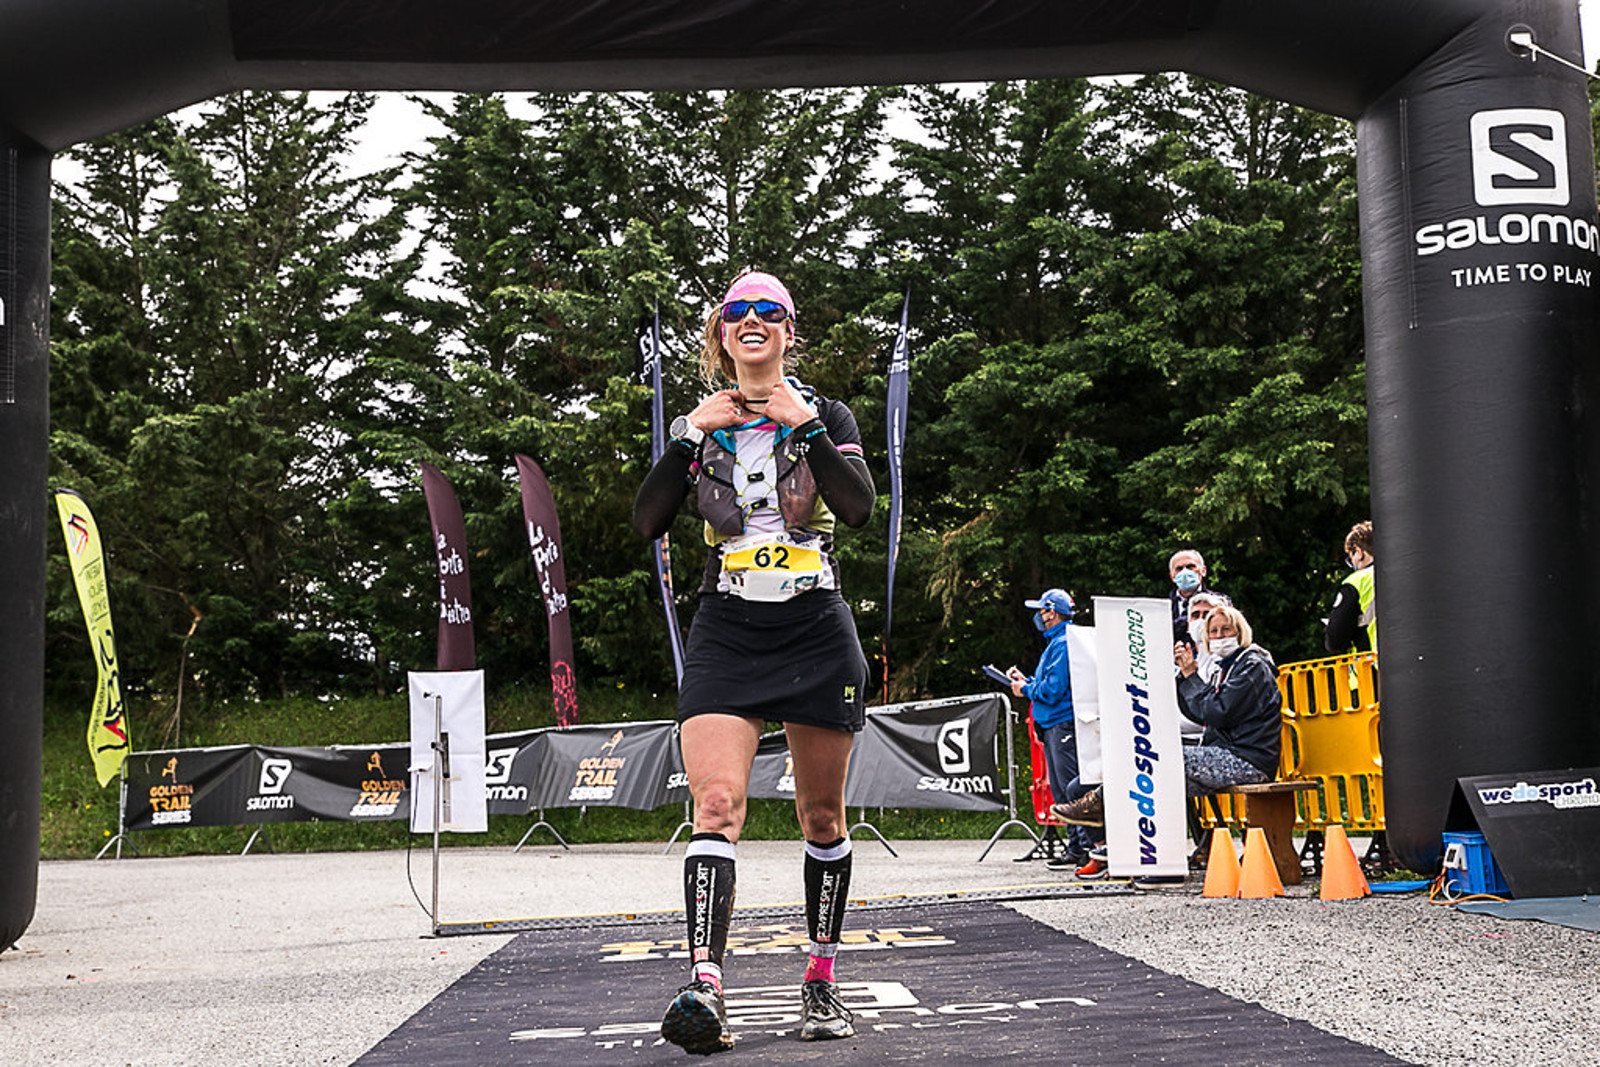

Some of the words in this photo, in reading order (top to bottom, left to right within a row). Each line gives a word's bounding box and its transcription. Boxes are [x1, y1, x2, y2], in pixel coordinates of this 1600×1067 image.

[1451, 265, 1510, 287] TIME
[1516, 263, 1547, 282] TO
[1553, 265, 1592, 288] PLAY
[754, 546, 790, 569] 62
[579, 757, 626, 769] GOLDEN
[362, 780, 408, 792] GOLDEN
[575, 769, 618, 787] TRAIL
[150, 784, 194, 797] GOLDEN
[358, 791, 401, 805] TRAIL
[1481, 781, 1593, 802] wedosport
[149, 796, 192, 812] TRAIL
